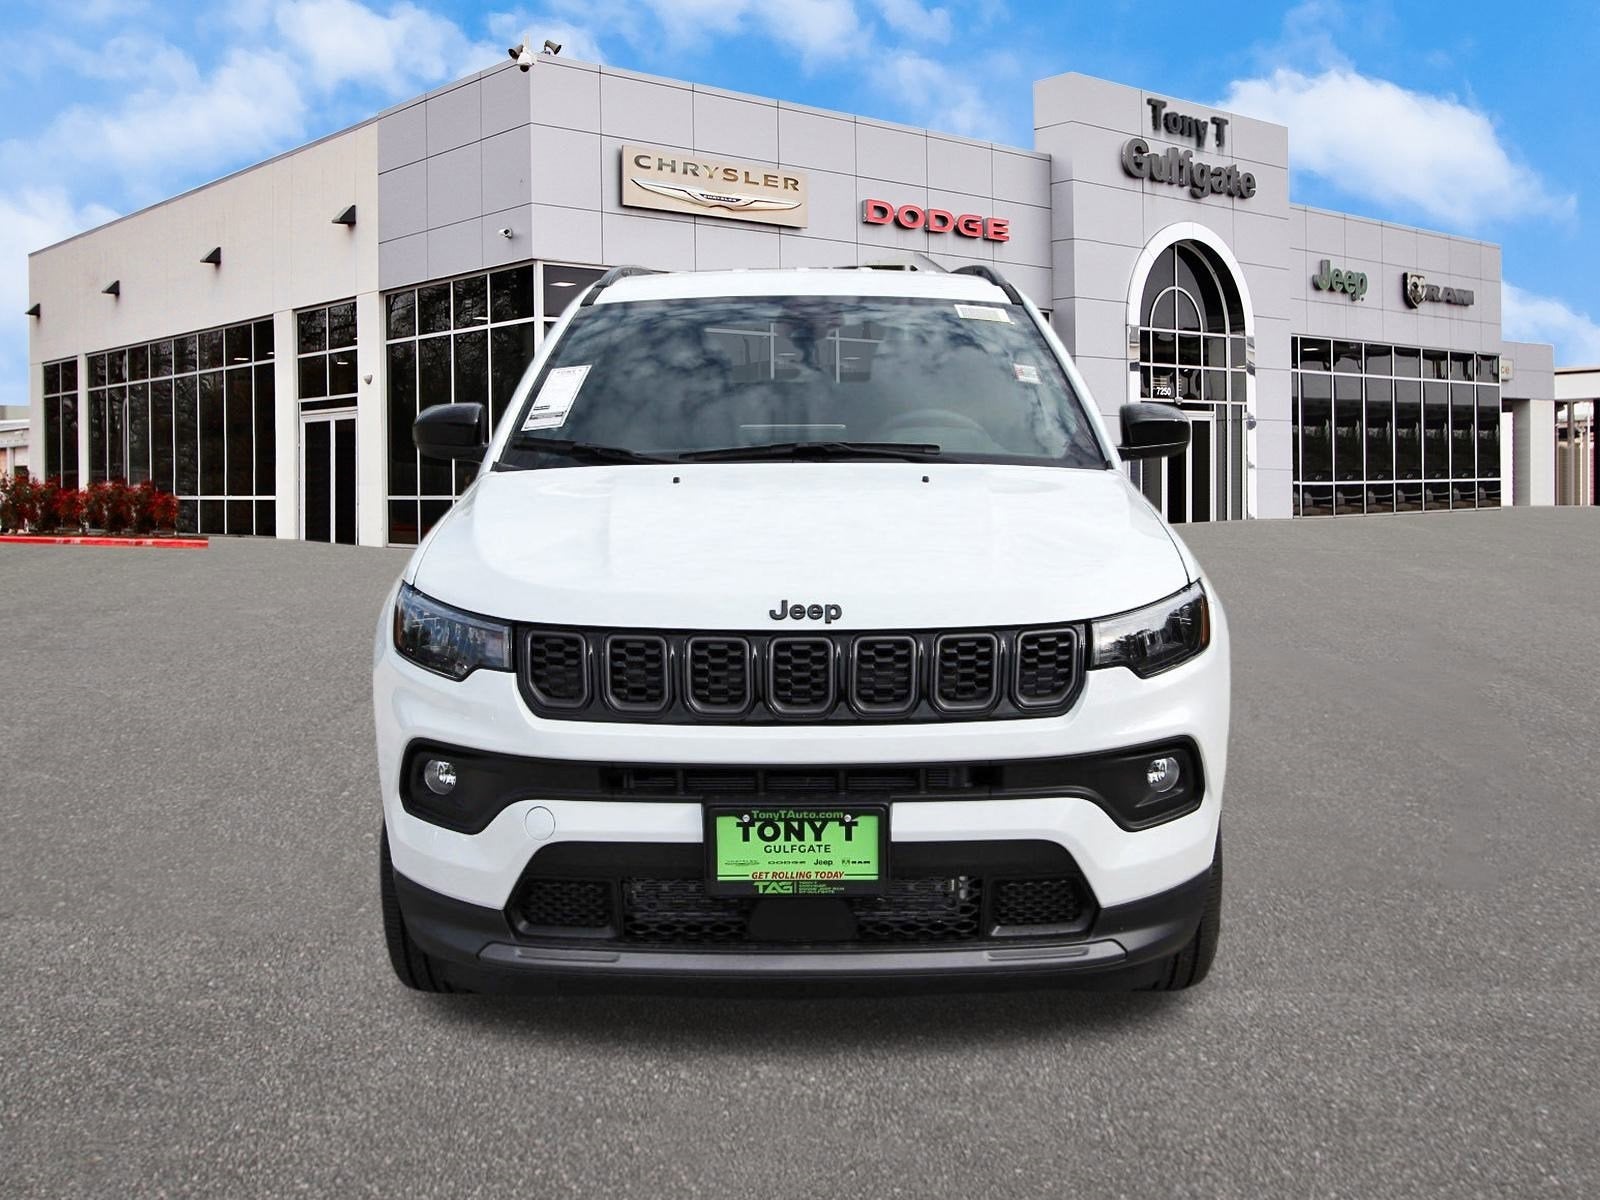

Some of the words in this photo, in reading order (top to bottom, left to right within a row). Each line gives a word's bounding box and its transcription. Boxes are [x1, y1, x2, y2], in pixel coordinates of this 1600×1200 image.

[1147, 98, 1208, 147] Tony
[1211, 116, 1229, 147] T
[633, 153, 800, 191] CHRYSLER
[1121, 137, 1256, 199] Gulfgate
[863, 198, 1010, 242] DODGE
[1312, 259, 1368, 302] Jeep
[1425, 284, 1474, 306] RAM
[1156, 386, 1172, 396] 7250
[769, 600, 842, 624] Jeep
[751, 810, 843, 821] TonyTAuto.com
[736, 820, 830, 842] TONY
[839, 820, 858, 842] T
[764, 844, 831, 854] GULFGATE
[813, 858, 833, 866] Jeep
[751, 871, 769, 880] GET
[771, 871, 812, 880] ROLLING
[814, 871, 844, 879] TODAY
